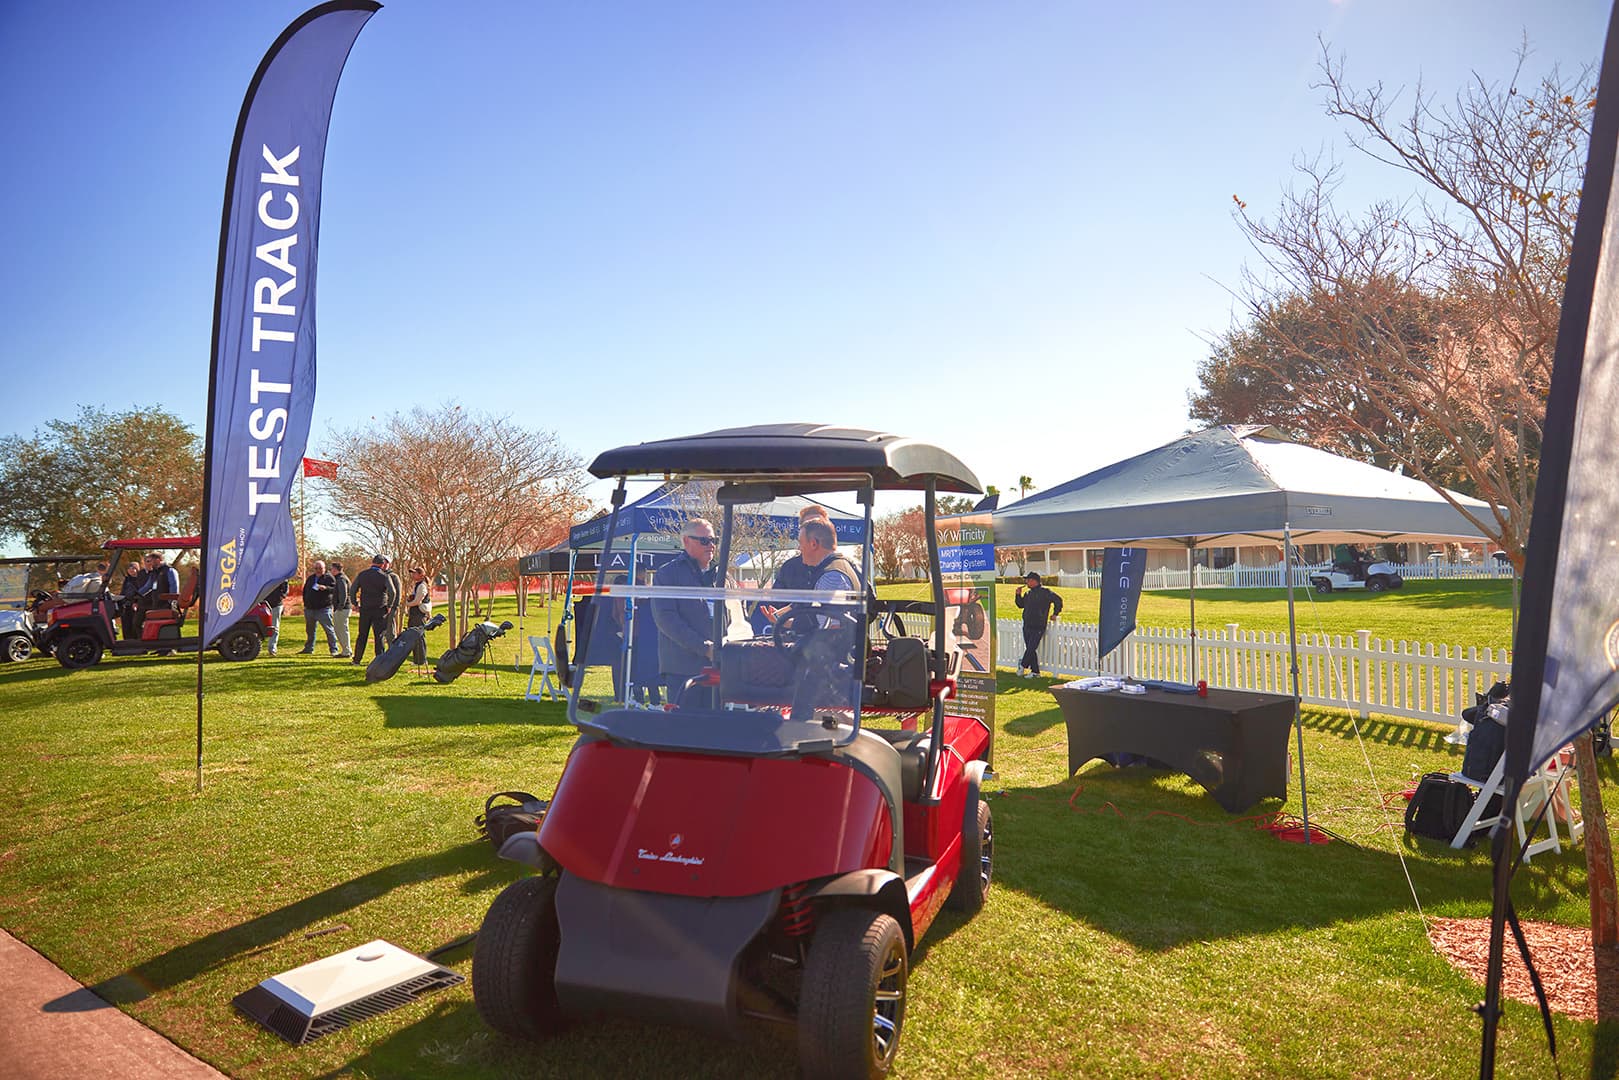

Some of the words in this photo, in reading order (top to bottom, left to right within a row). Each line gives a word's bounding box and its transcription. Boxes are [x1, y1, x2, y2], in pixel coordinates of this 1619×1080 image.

[250, 143, 301, 353] TRACK
[248, 369, 293, 516] TEST
[849, 525, 861, 534] EV
[949, 528, 986, 543] WiTricity
[220, 537, 237, 590] PGA
